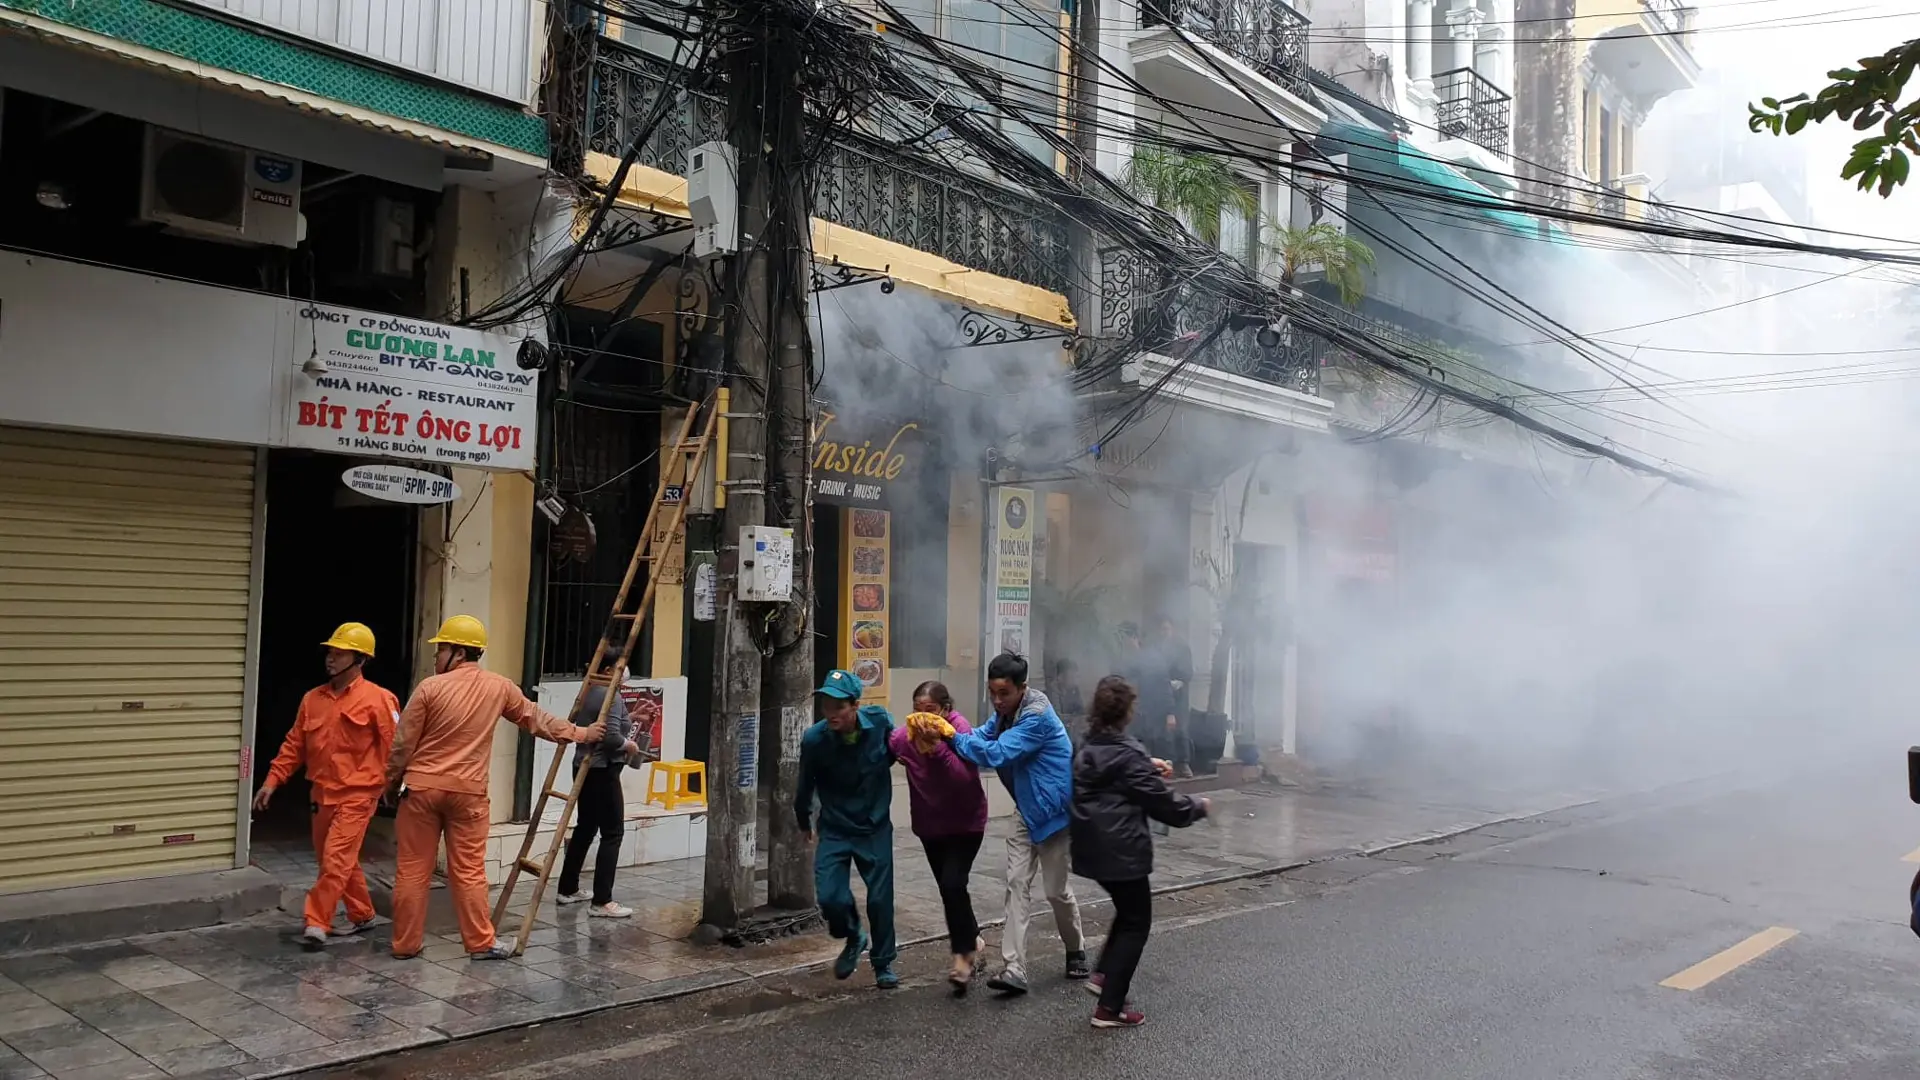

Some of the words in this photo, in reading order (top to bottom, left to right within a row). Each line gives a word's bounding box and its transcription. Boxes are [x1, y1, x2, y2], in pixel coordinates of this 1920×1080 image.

[254, 190, 290, 206] Funiki
[360, 317, 376, 328] CP
[443, 344, 495, 368] LAN
[506, 373, 534, 386] TAY
[316, 377, 351, 391] NHÀ
[356, 381, 402, 397] HÀNG
[418, 390, 515, 412] RESTAURANT
[297, 396, 347, 429] BÍT
[355, 399, 409, 436] TẾT
[416, 409, 471, 443] ÔNG
[478, 423, 521, 452] LỢI
[338, 437, 350, 446] 51
[354, 436, 389, 450] HÀNG
[436, 447, 466, 460] (trong
[818, 479, 847, 497] DRINK
[853, 483, 881, 500] MUSIC
